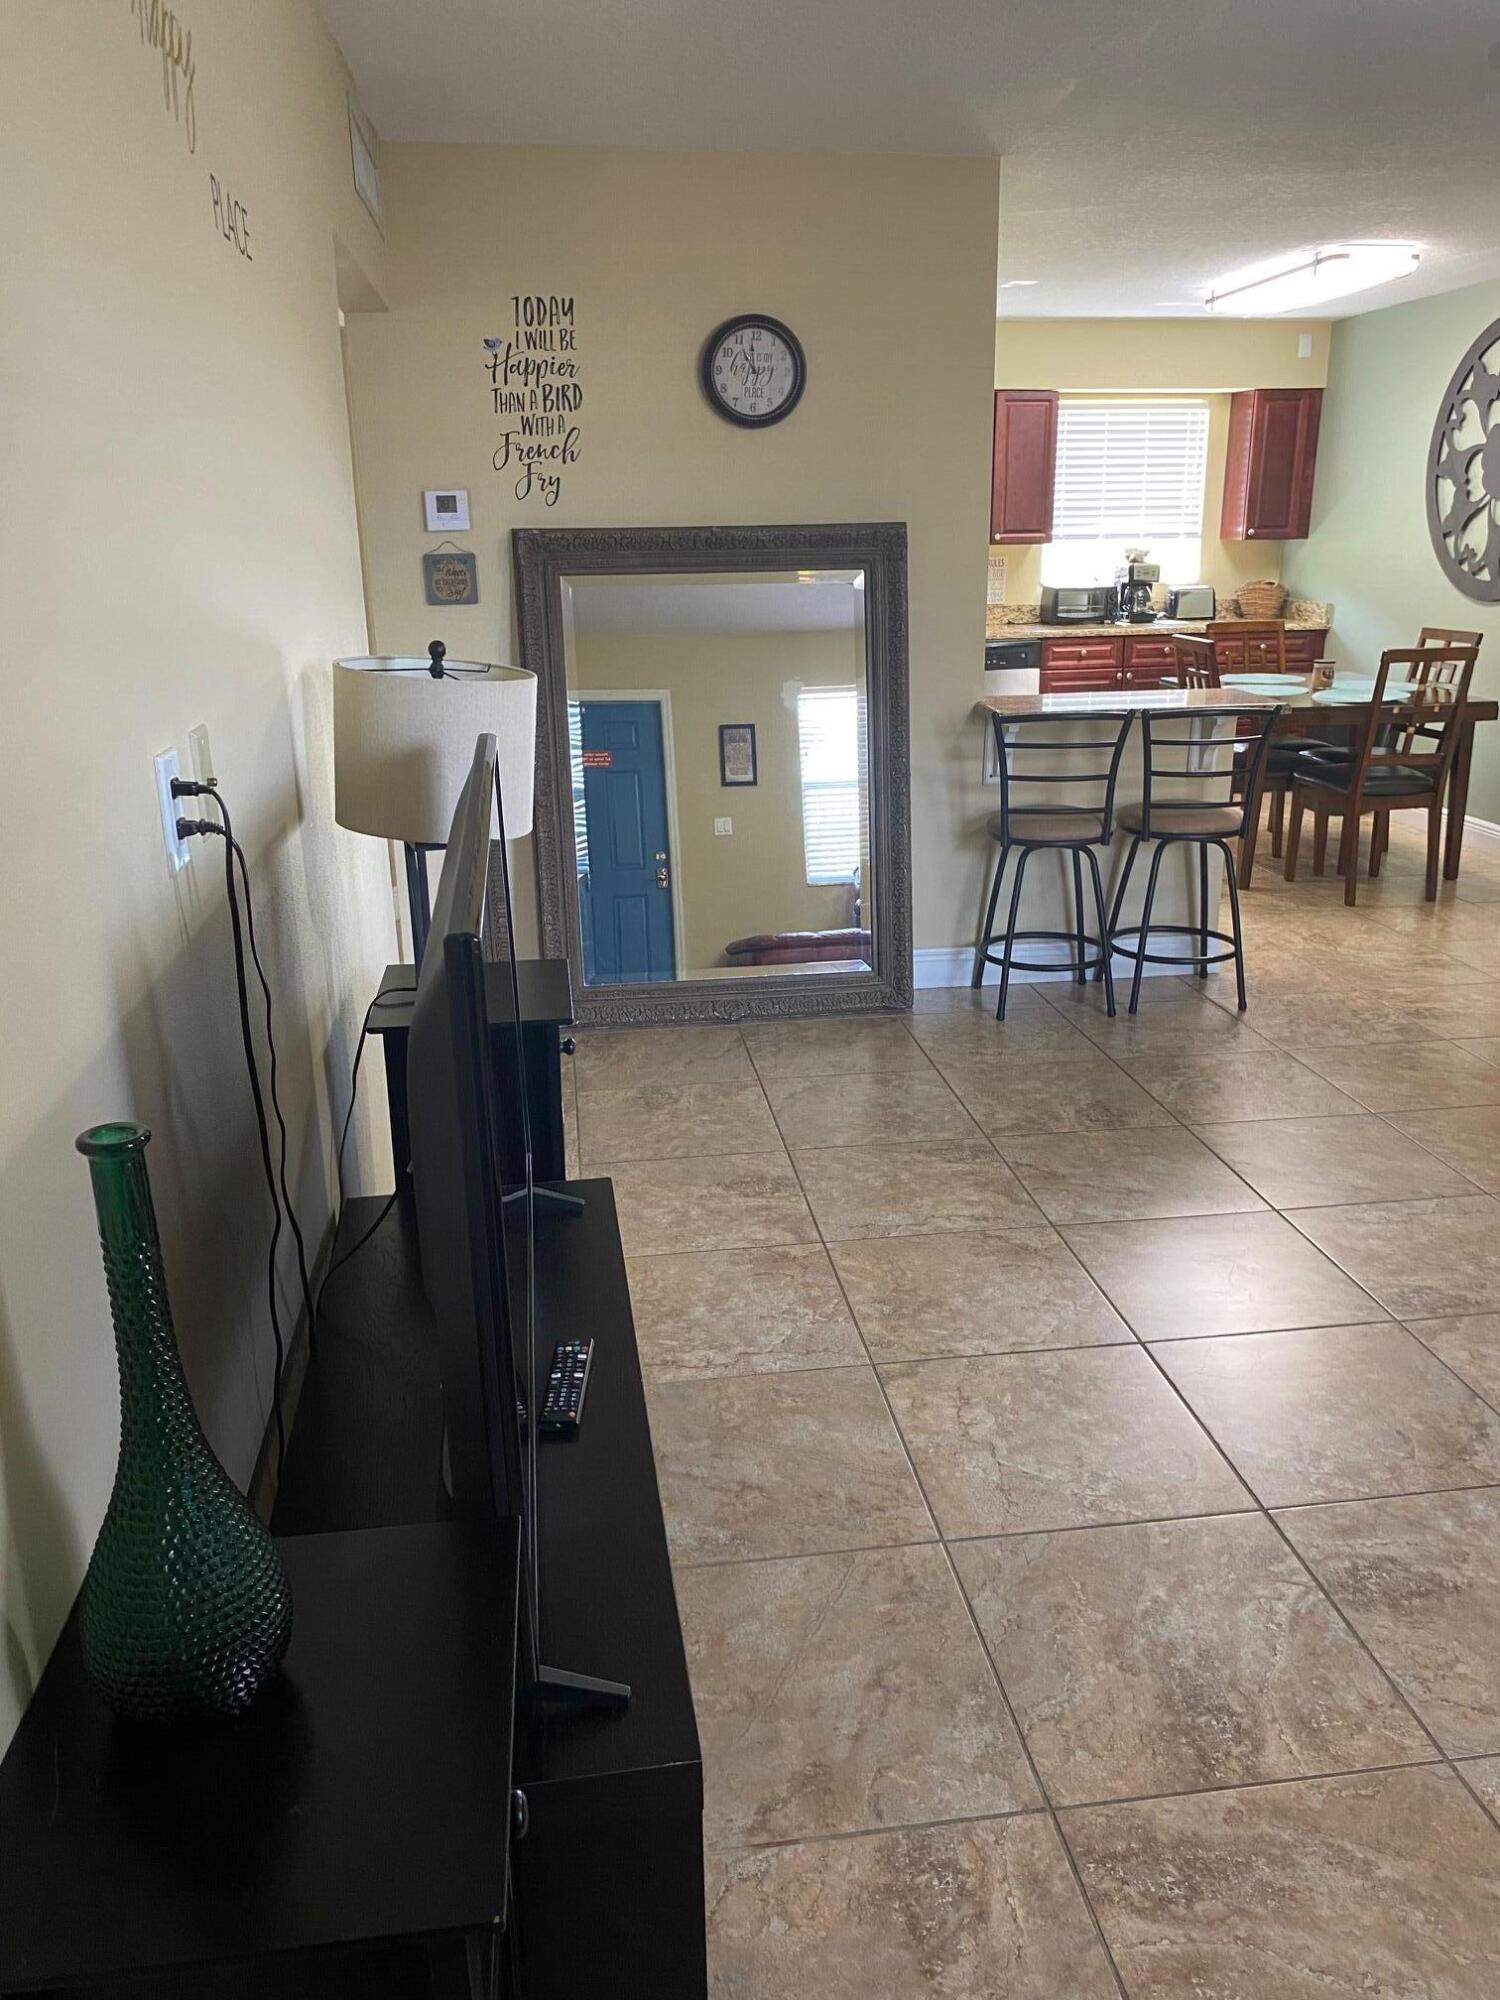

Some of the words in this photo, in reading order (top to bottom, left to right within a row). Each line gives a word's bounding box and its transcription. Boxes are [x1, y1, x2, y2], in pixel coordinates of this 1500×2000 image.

[209, 172, 252, 262] PLACE
[510, 295, 574, 327] TODAY
[515, 330, 520, 350] I
[524, 328, 557, 351] WILL
[560, 328, 578, 351] BE
[735, 334, 743, 345] 11
[752, 330, 762, 341] 12
[723, 347, 733, 358] 10
[485, 342, 580, 388] Happier
[715, 366, 723, 375] 9
[491, 387, 525, 414] THAN
[530, 389, 538, 411] A
[542, 383, 583, 413] BIRD
[719, 384, 727, 394] 8
[732, 397, 740, 408] 7
[750, 402, 757, 413] 6
[521, 414, 554, 437] WITH
[558, 414, 566, 434] A
[492, 427, 582, 471] French
[515, 460, 561, 507] Fry
